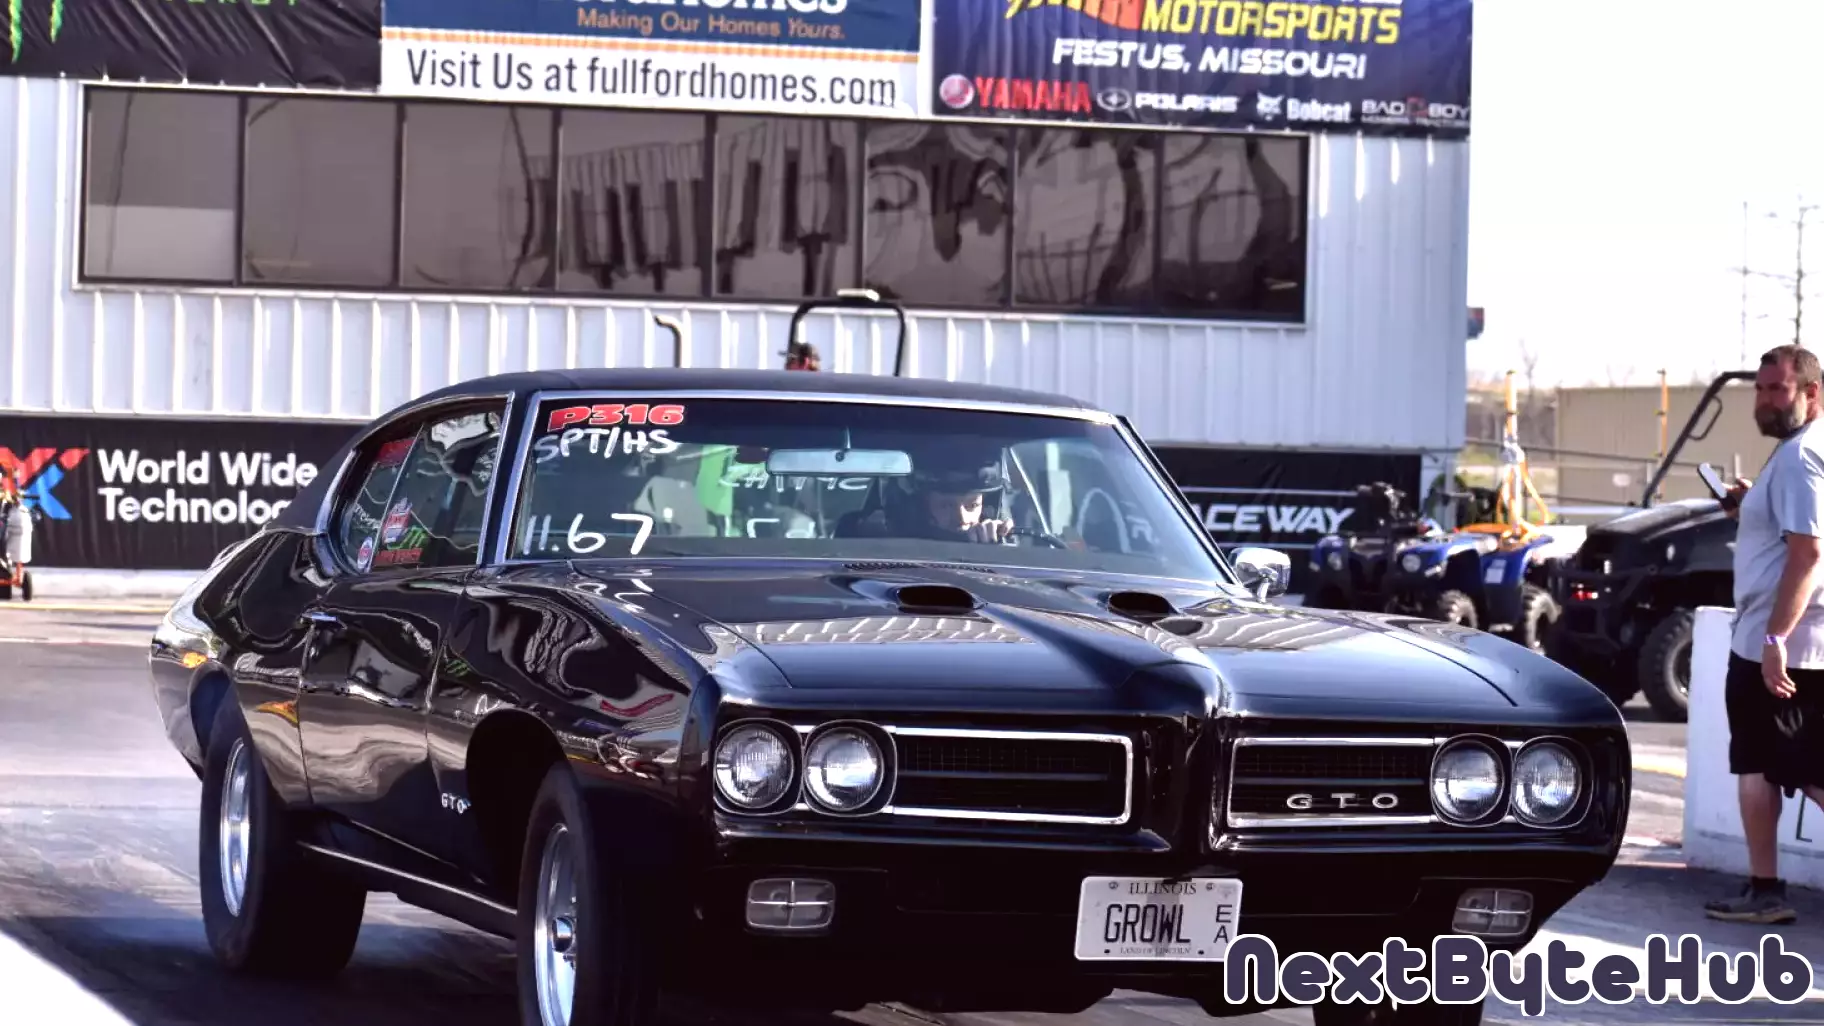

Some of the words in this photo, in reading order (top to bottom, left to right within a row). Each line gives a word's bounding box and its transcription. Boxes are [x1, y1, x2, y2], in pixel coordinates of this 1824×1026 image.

[577, 7, 653, 35] Making
[660, 11, 700, 32] Our
[708, 15, 781, 37] Homes
[787, 17, 846, 40] Yours.
[1141, 0, 1402, 45] MOTORSPORTS
[1052, 38, 1191, 73] FESTUS,
[1198, 46, 1366, 79] MISSOURI
[406, 48, 482, 89] Visit
[491, 53, 535, 92] Us
[543, 59, 578, 94] at
[586, 59, 897, 108] fullfordhomes.com
[975, 77, 1092, 112] YAMAHA
[1135, 92, 1239, 113] POLARIS
[1286, 98, 1352, 121] Bobcat
[1361, 99, 1405, 115] BAD
[1428, 103, 1470, 119] BOY
[548, 404, 685, 432] P316
[534, 428, 682, 463] SPT/HS
[98, 448, 213, 486] World
[221, 451, 318, 488] Wide
[523, 513, 654, 556] 11.67
[441, 792, 466, 814] GTO
[1286, 793, 1399, 809] GTO
[1128, 882, 1197, 895] ILLINOIS
[1104, 904, 1191, 943] GROWL
